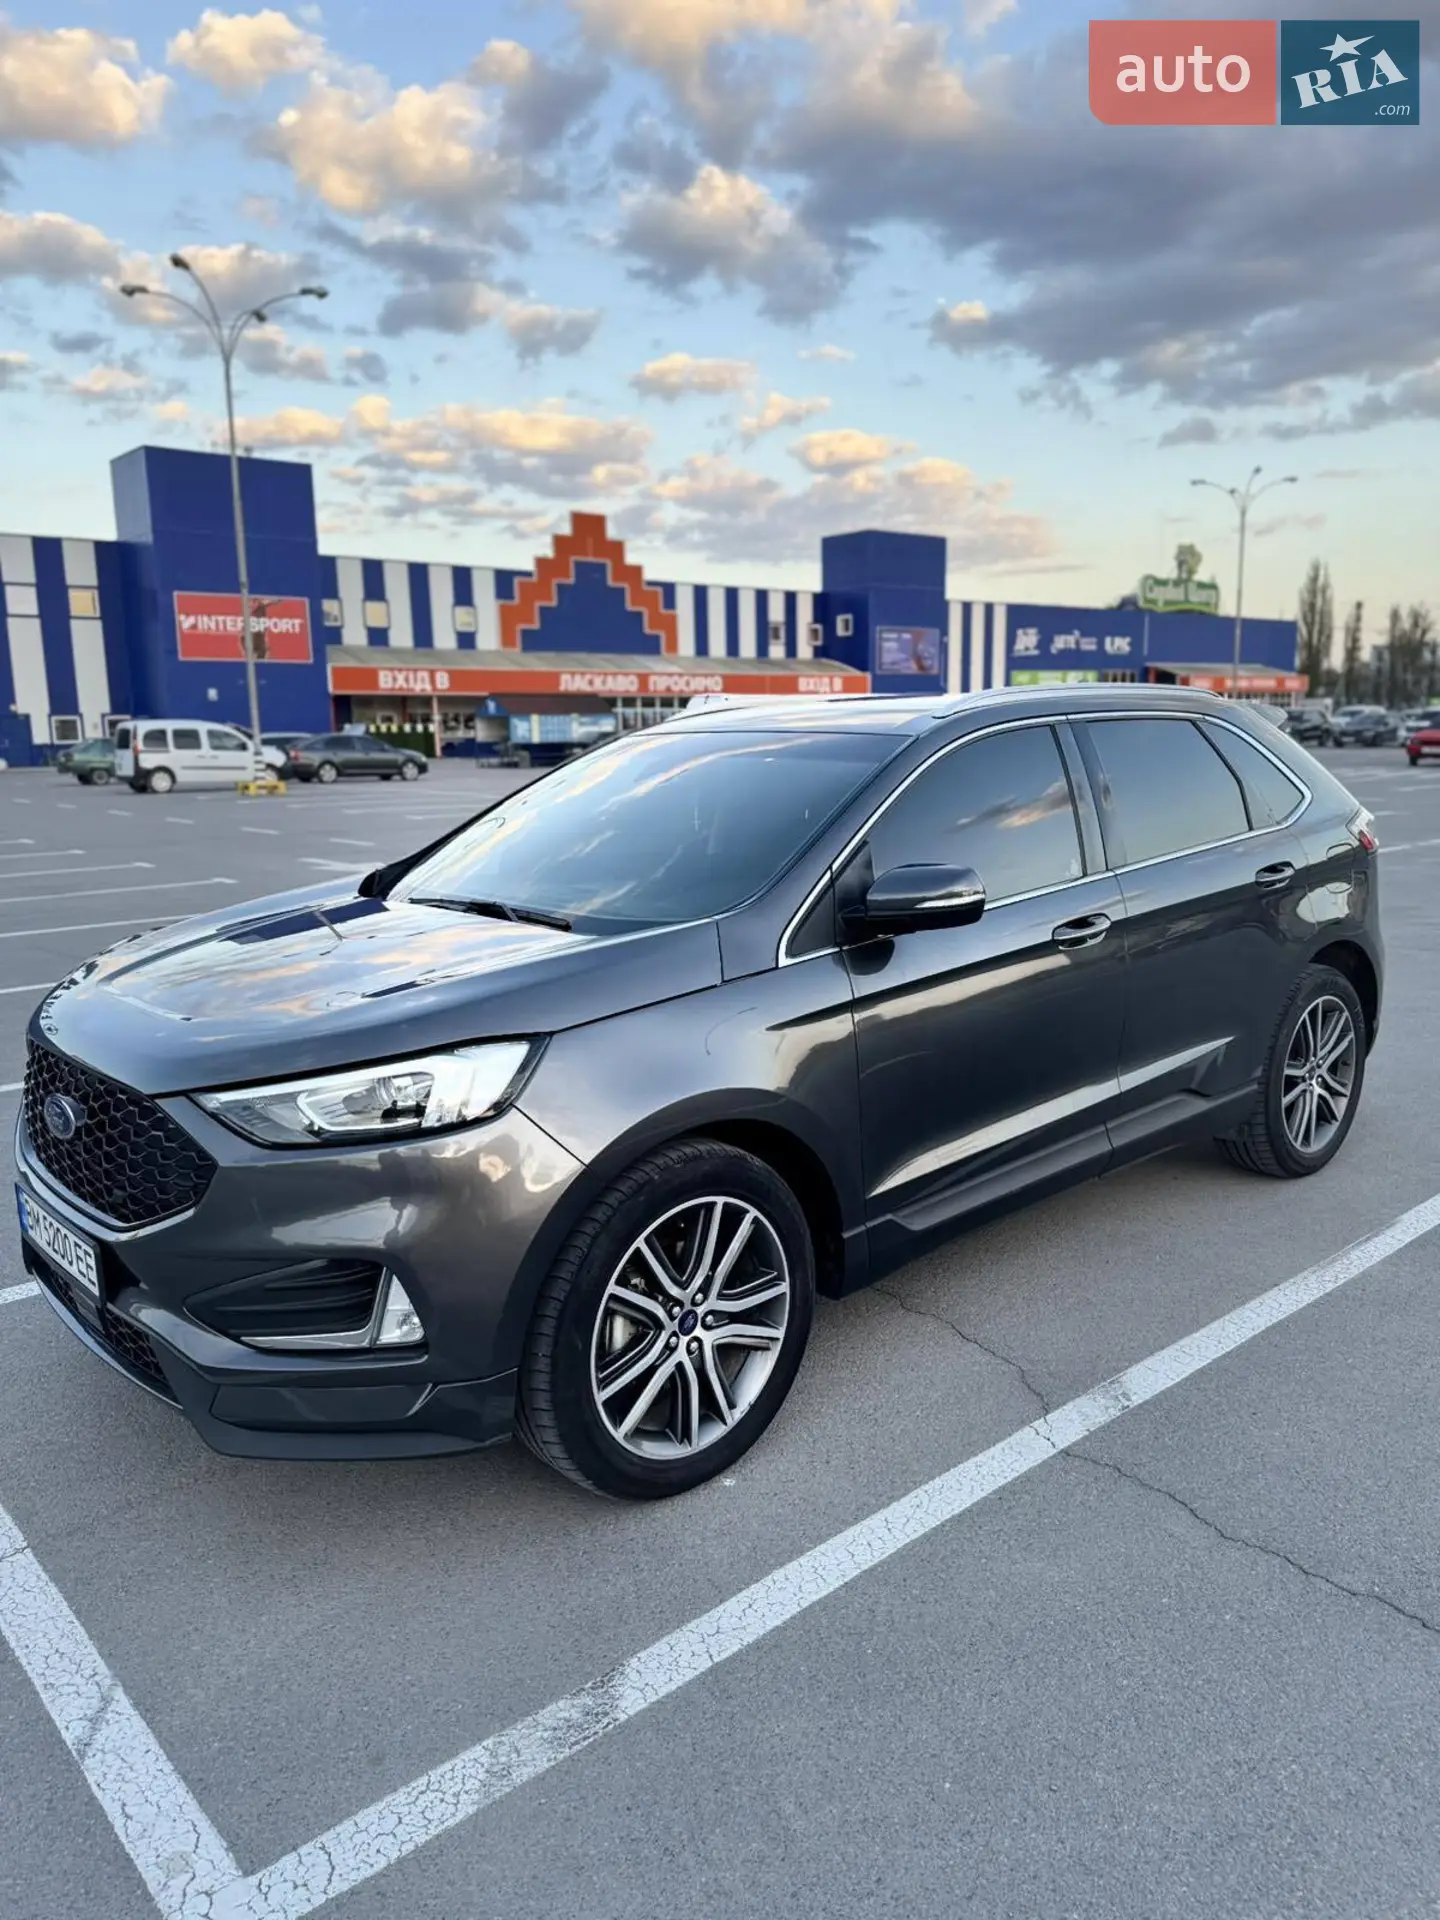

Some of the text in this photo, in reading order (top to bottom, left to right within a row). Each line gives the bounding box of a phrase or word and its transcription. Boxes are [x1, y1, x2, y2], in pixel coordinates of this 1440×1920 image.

[378, 669, 450, 691] ВХІД В
[559, 672, 724, 693] ЛАСКАВО ПРОСИМО
[42, 1214, 74, 1267] 5200
[74, 1241, 97, 1287] EE
